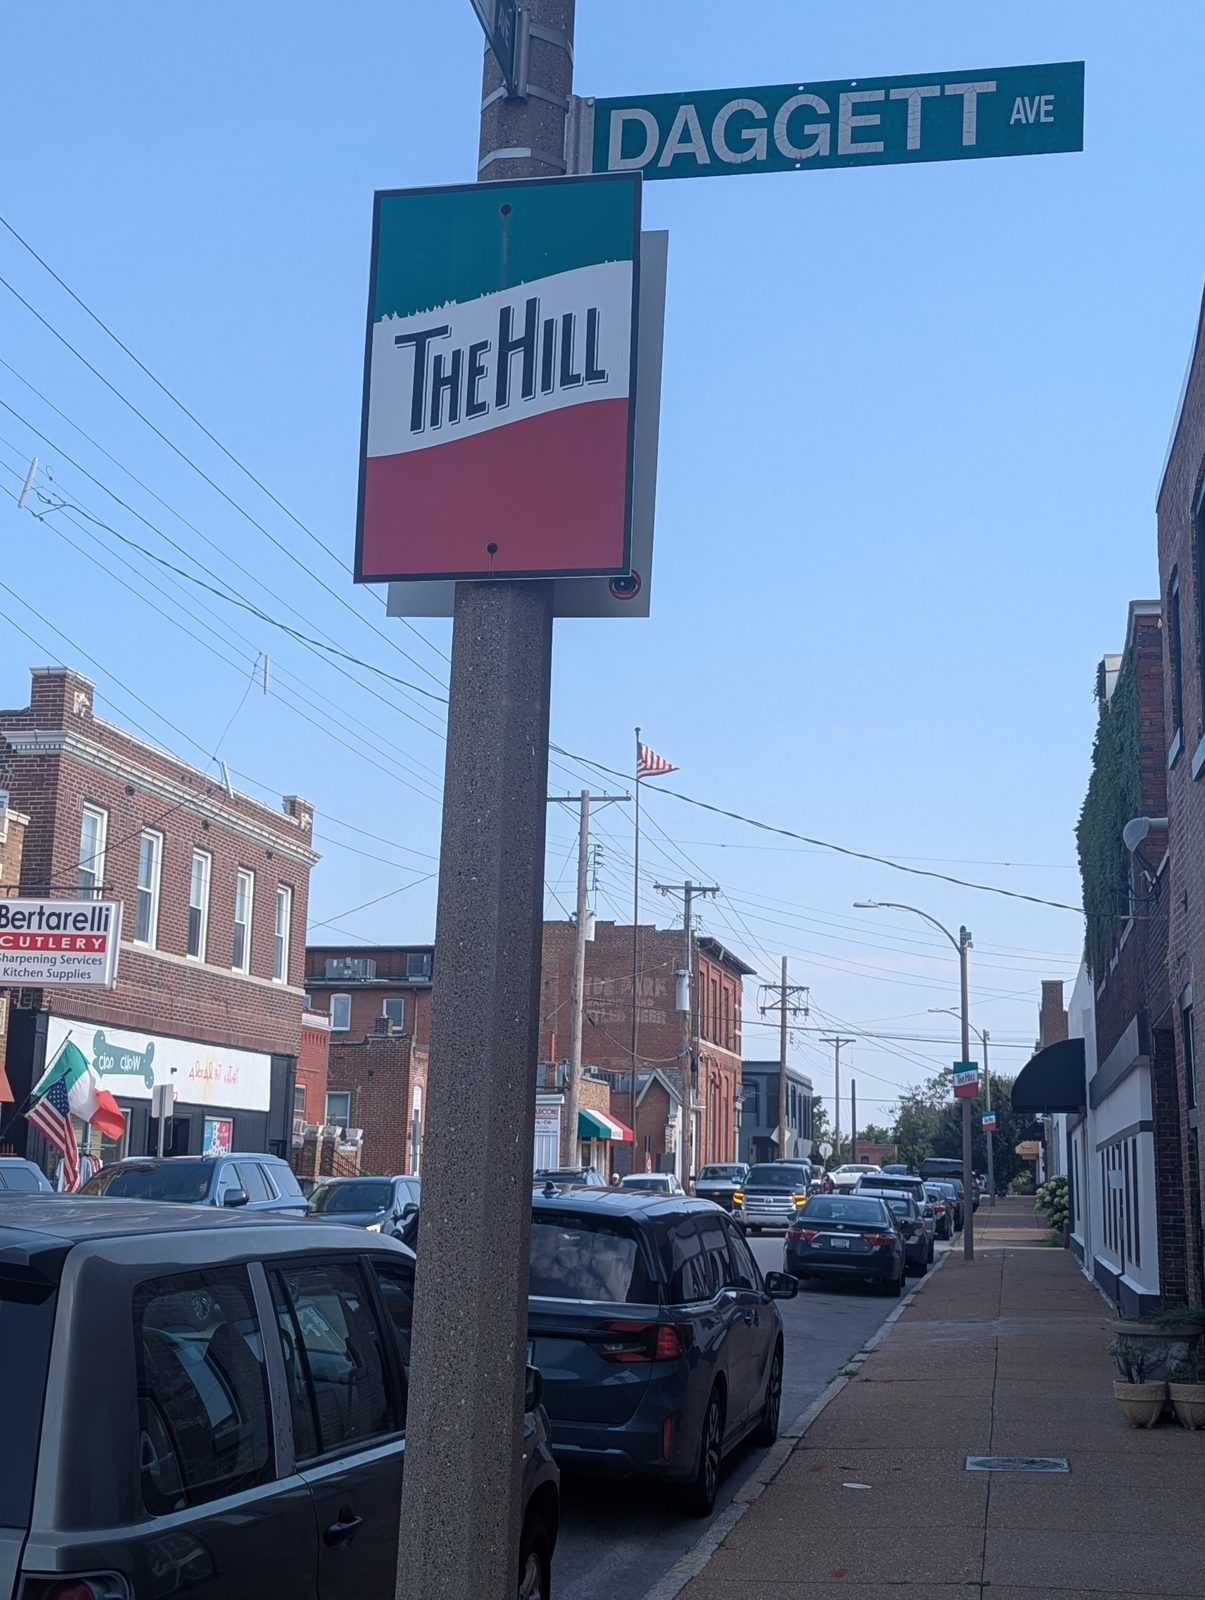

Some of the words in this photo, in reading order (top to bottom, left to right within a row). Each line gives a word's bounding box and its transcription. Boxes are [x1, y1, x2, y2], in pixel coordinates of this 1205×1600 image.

[608, 80, 997, 171] DAGGETT
[1010, 94, 1055, 125] AVE
[0, 904, 110, 932] Bertarelli
[0, 935, 104, 949] CUTLERY
[60, 954, 103, 966] Services
[3, 966, 43, 978] Kitchen
[46, 968, 91, 981] Supplies
